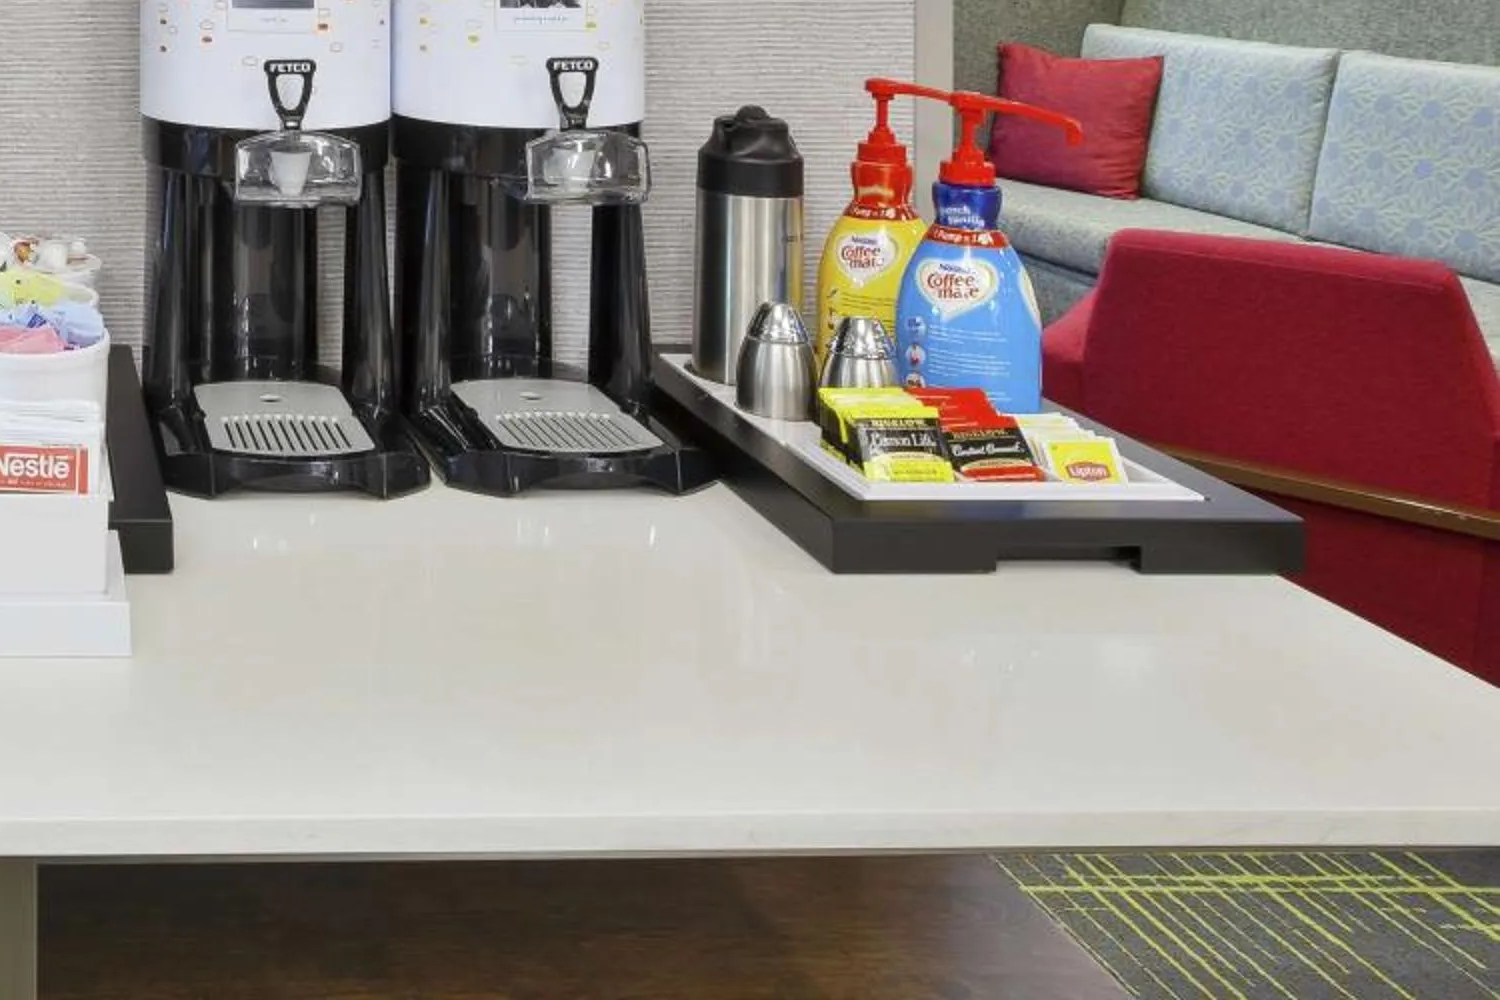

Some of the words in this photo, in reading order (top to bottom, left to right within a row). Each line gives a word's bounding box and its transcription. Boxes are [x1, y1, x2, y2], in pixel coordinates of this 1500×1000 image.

[269, 62, 311, 73] FETCO
[553, 61, 593, 71] FETCO
[841, 245, 882, 261] Coffee
[927, 272, 975, 289] Coffee
[1070, 466, 1109, 479] Lipton
